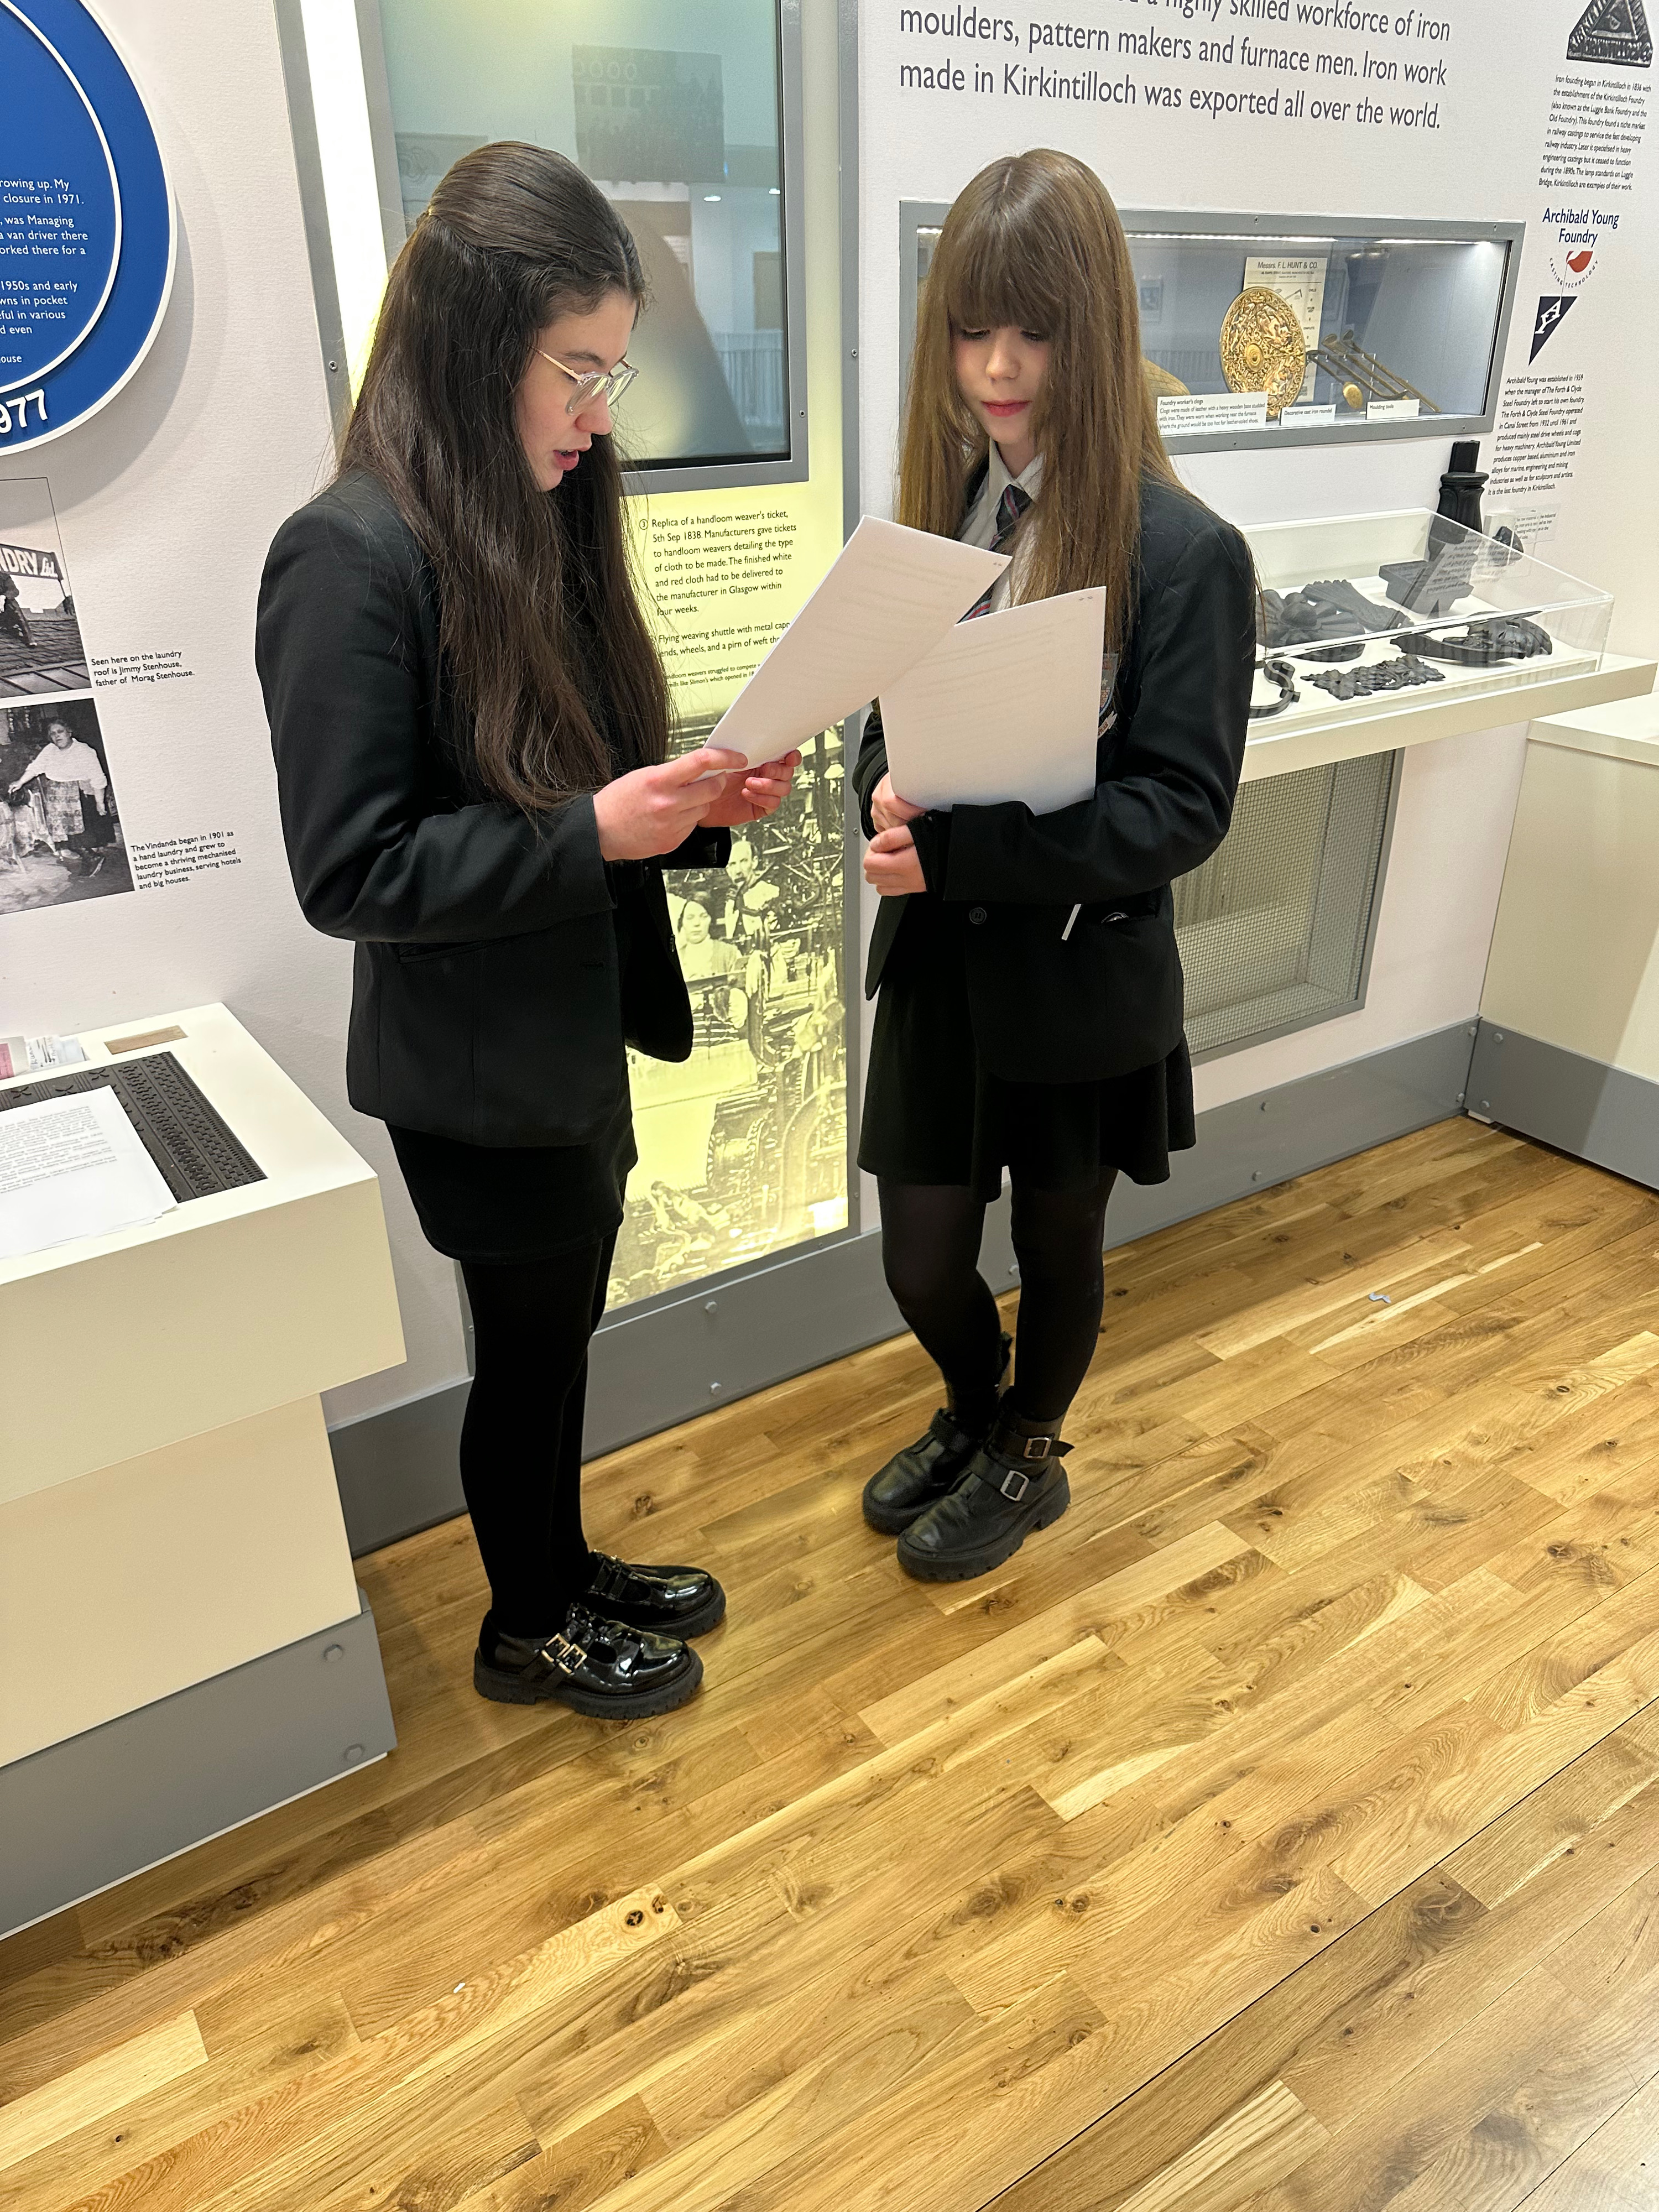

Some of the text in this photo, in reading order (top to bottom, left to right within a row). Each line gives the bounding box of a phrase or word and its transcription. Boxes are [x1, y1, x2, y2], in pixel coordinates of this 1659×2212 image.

[1230, 0, 1289, 21] skilled
[1297, 0, 1388, 33] workforce
[1395, 9, 1415, 36] of
[1417, 13, 1449, 41] iron
[901, 5, 1447, 85] moulders, pattern makers and furnace men. Iron work
[901, 59, 1439, 128] made in Kirkintilloch was exported all over the world.
[38, 181, 52, 191] up.
[54, 179, 69, 191] My
[3, 193, 84, 204] closure in 1971.
[28, 215, 74, 228] Managing
[1542, 208, 1619, 229] Archibald Young
[28, 230, 58, 239] driver
[61, 231, 88, 240] there
[1559, 228, 1598, 248] Foundry
[32, 245, 59, 254] there
[62, 245, 76, 254] for
[1, 281, 77, 292] 1950s and early
[34, 295, 67, 307] pocket
[652, 519, 678, 529] Replica
[681, 517, 688, 525] of
[697, 515, 732, 524] handloom
[735, 511, 764, 520] weaver's
[667, 533, 680, 543] Sep
[705, 529, 755, 538] Manufacturers
[758, 528, 772, 536] gave
[664, 547, 700, 556] handloom
[734, 541, 763, 550] detailing
[665, 562, 682, 571] cloth
[744, 554, 770, 563] finished
[671, 590, 718, 599] manufacturer
[729, 586, 758, 594] Glasgow
[675, 604, 699, 613] weeks.
[659, 634, 680, 645] Flying
[712, 627, 734, 637] shuttle
[737, 625, 752, 633] with
[754, 622, 773, 632] metal
[119, 666, 140, 675] Jimmy
[145, 839, 177, 849] Vindanda
[198, 848, 236, 860] mechanised
[137, 872, 163, 880] laundry
[165, 867, 194, 875] business,
